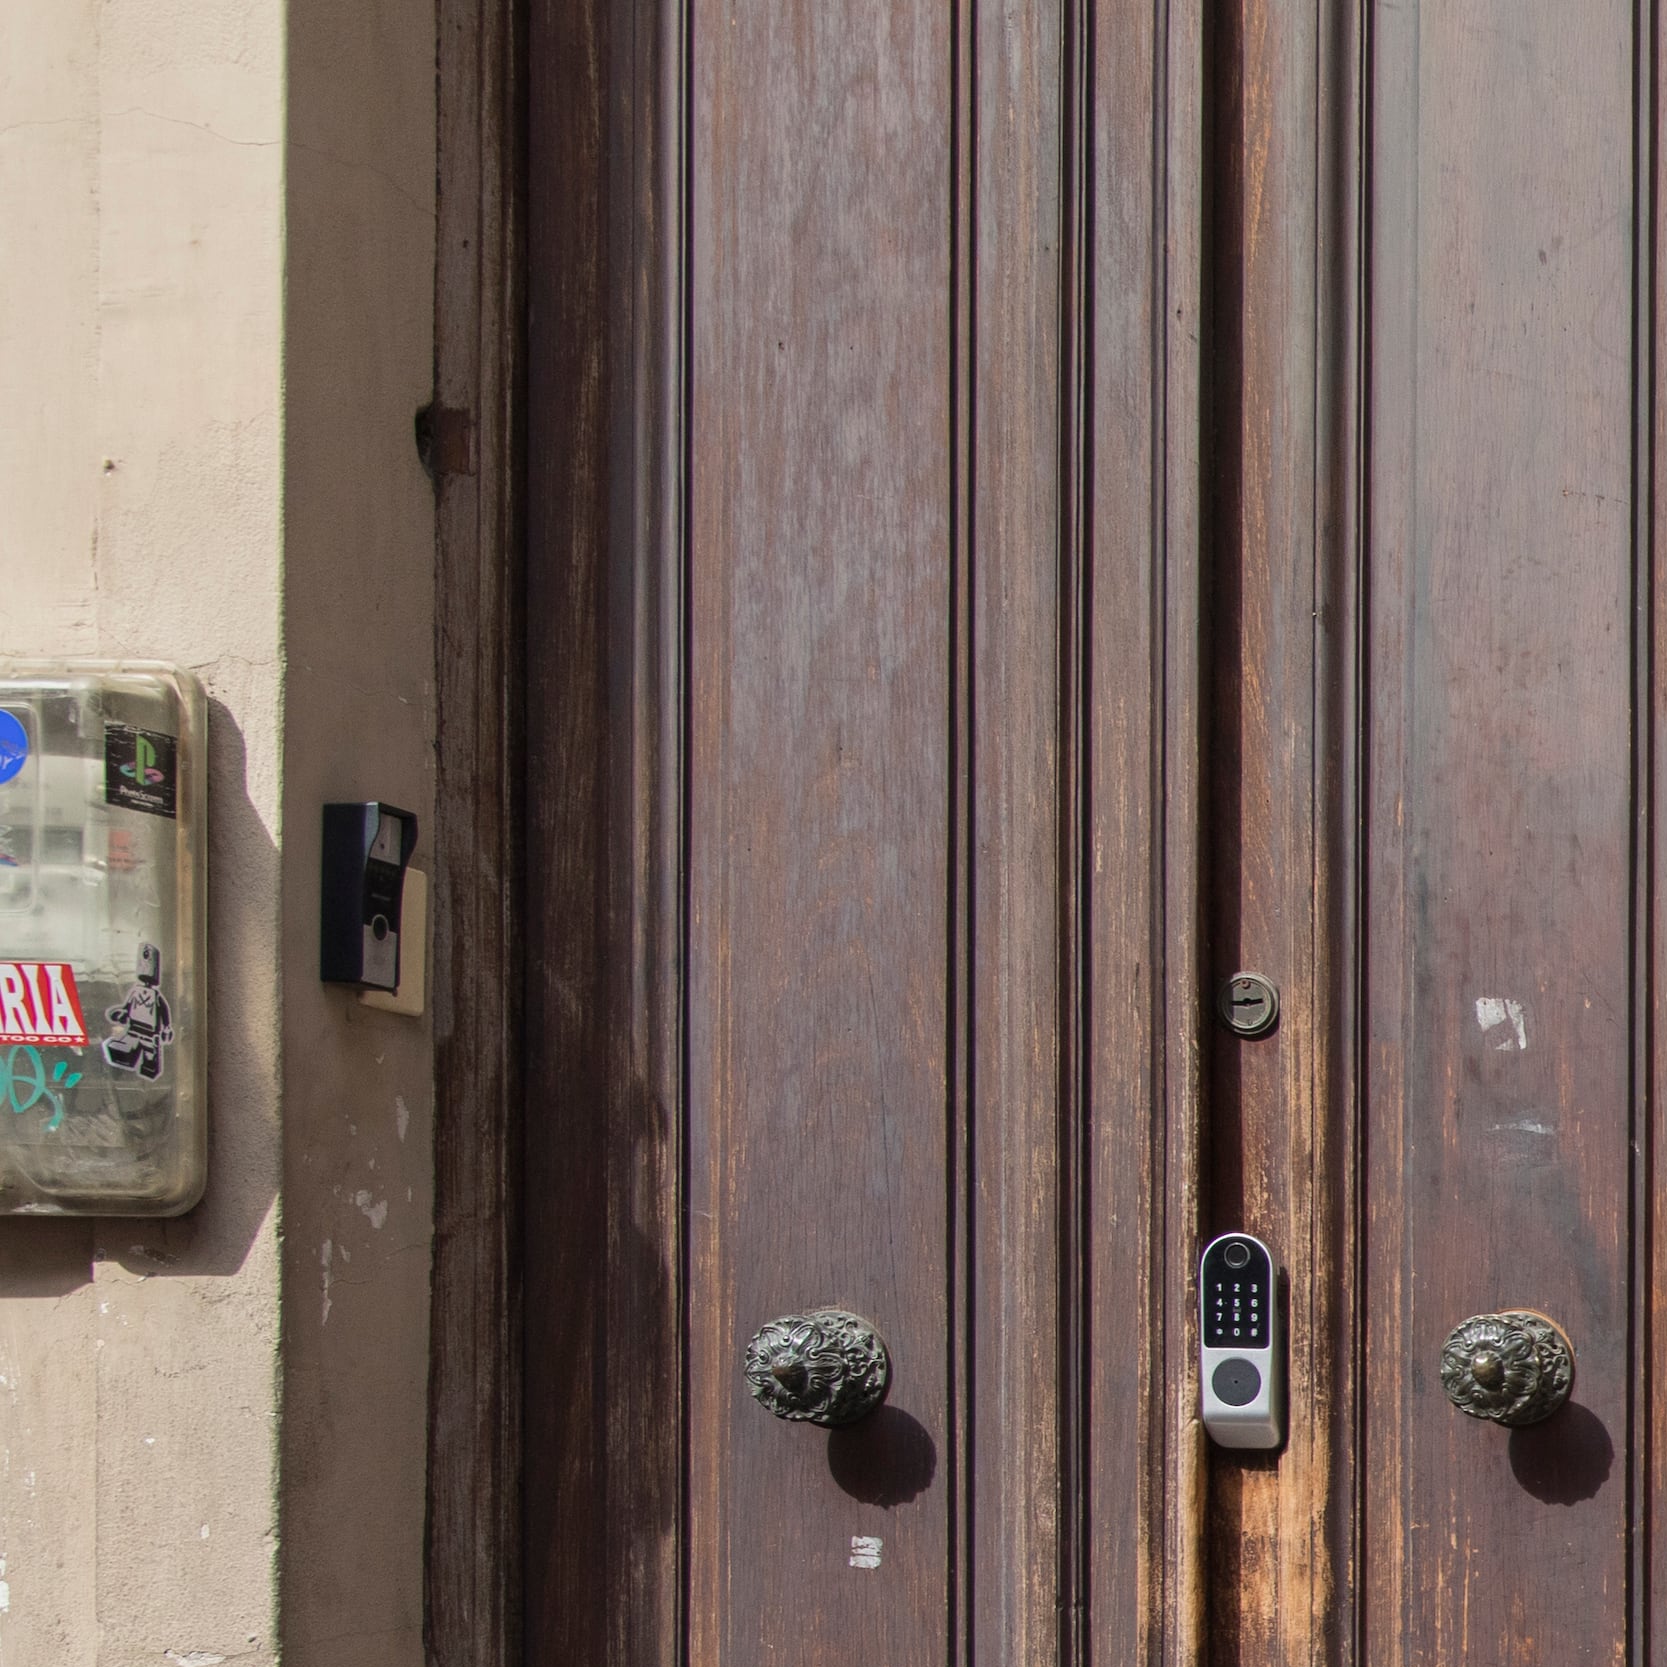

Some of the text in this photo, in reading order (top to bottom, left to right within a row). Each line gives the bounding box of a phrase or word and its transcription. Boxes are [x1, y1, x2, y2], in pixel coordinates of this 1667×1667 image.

[0, 963, 84, 1036] RIA
[42, 1035, 73, 1044] CO
[1216, 1283, 1258, 1293] 1 2 3
[1216, 1298, 1258, 1307] 4 5 6
[1216, 1313, 1258, 1322] 7 8 9
[1233, 1328, 1241, 1337] 0
